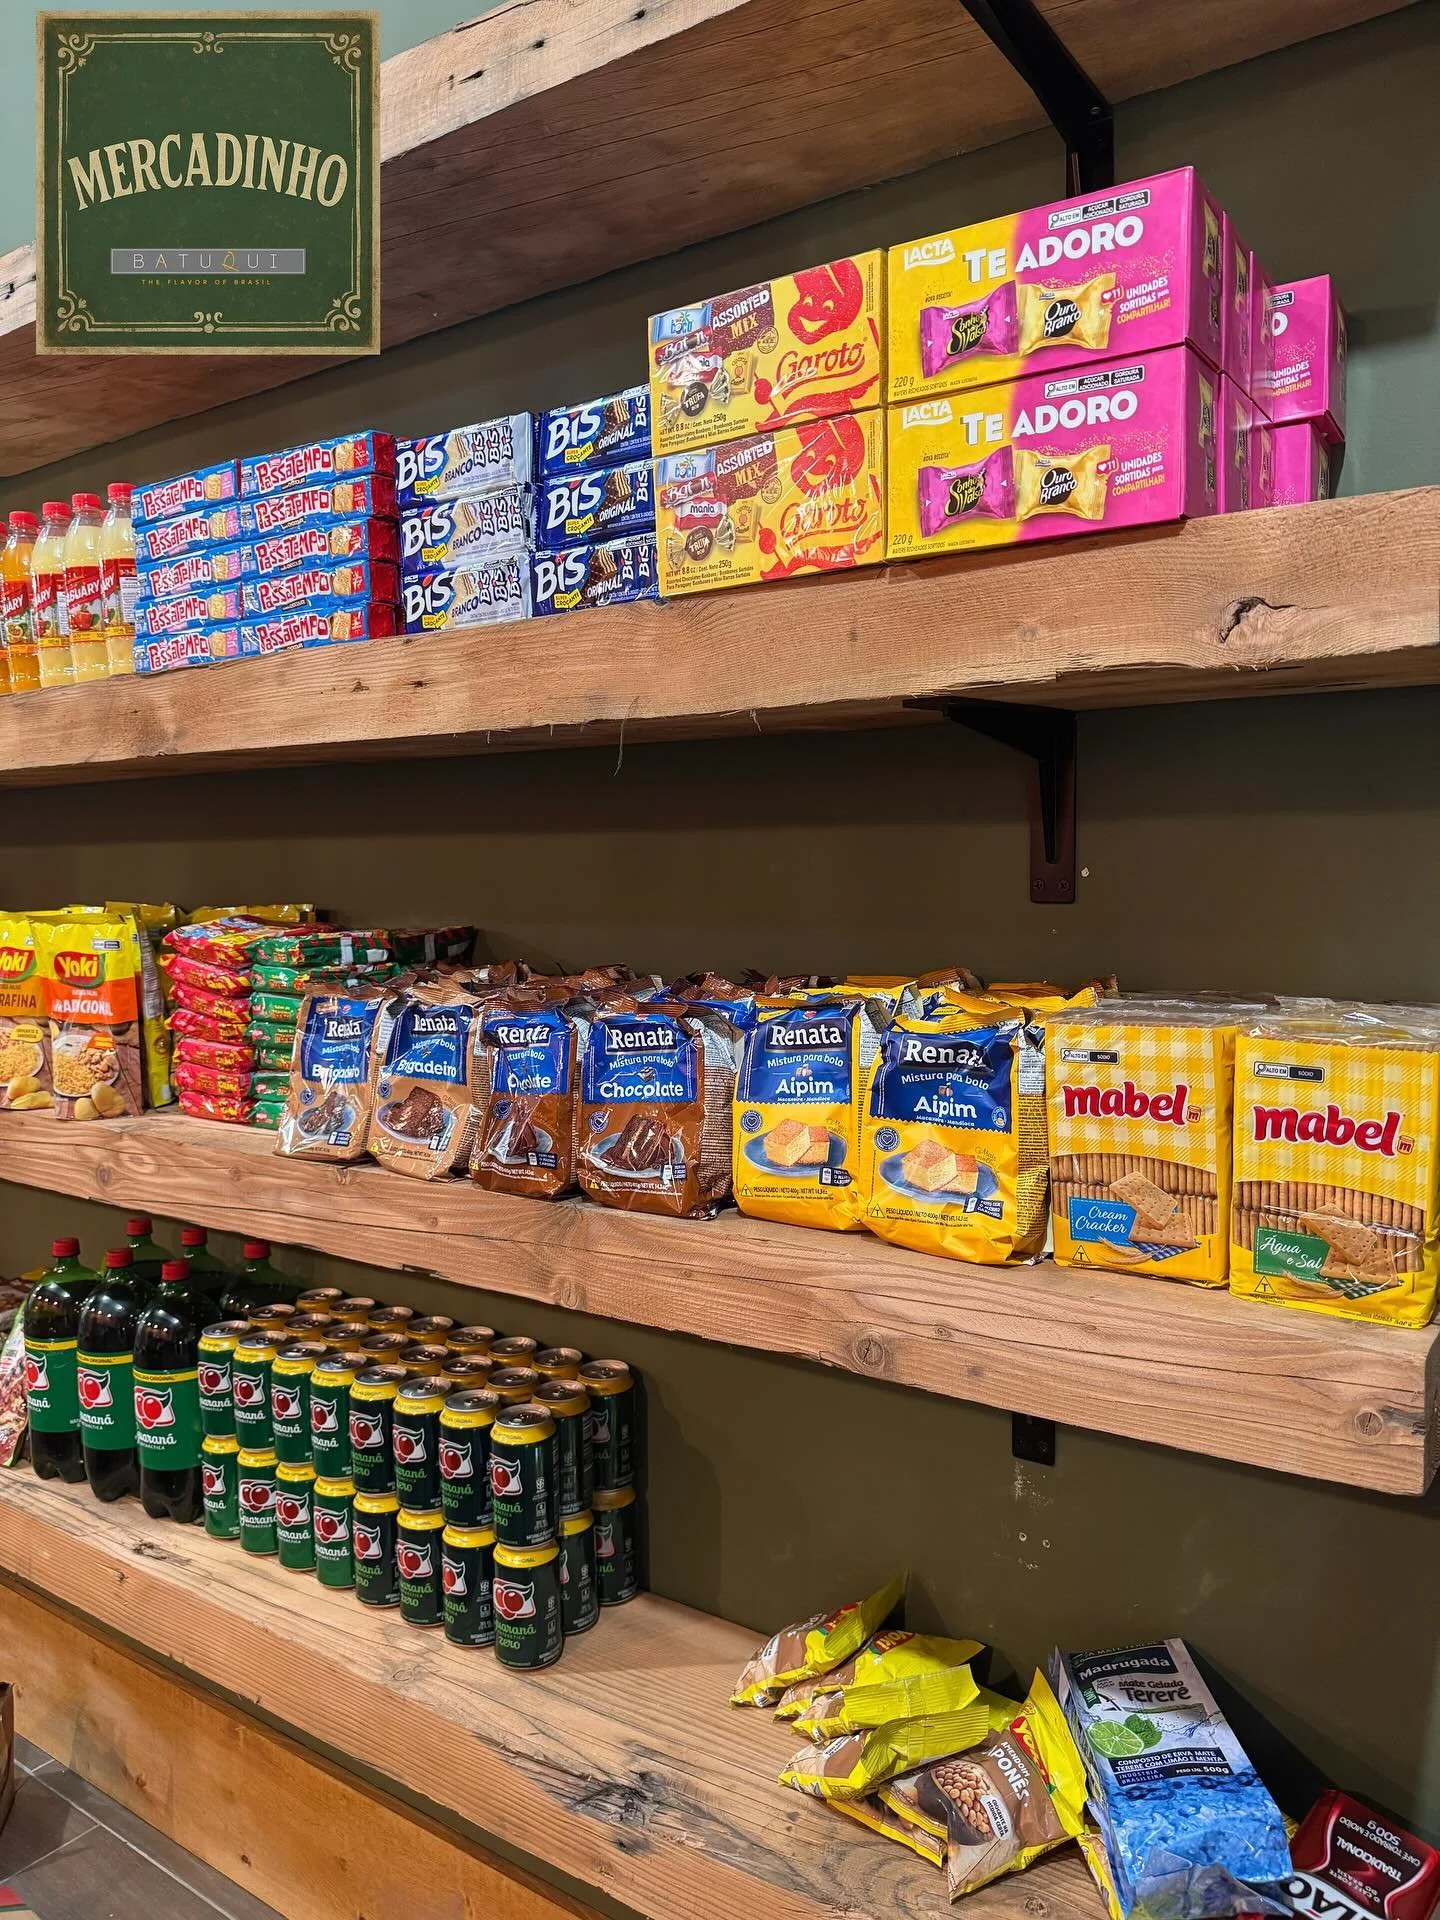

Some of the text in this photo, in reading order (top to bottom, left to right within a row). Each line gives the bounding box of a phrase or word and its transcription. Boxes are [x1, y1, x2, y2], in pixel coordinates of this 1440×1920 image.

[904, 238, 955, 268] LACTA
[964, 216, 1144, 282] TE ADORO
[1126, 276, 1168, 300] UNIDADES
[712, 290, 770, 331] ASSORTED
[1119, 292, 1156, 313] SORTIDAS
[730, 312, 759, 340] MIX
[1043, 309, 1082, 338] Branco
[776, 343, 865, 383] Garoto
[894, 376, 908, 388] 220
[713, 413, 727, 423] 250g
[902, 400, 952, 426] LACTA
[961, 390, 1138, 445] TE ADORO
[598, 422, 635, 450] ORIGINAL
[717, 440, 774, 477] ASSORTED
[1121, 452, 1163, 472] UNIDADES
[444, 458, 473, 483] BRANCO
[735, 464, 764, 488] MIX
[1114, 468, 1151, 486] SORTIDAS
[1040, 479, 1078, 505] Branco
[1112, 475, 1166, 497] COMPARTILHAR!
[599, 496, 636, 522] ORIGINAL
[690, 503, 715, 513] mania
[453, 529, 482, 550] BRANCO
[893, 534, 907, 545] 220
[719, 560, 732, 568] 250g
[68, 580, 99, 601] GUARY
[587, 576, 622, 597] ORIGINAL
[452, 595, 477, 618] BRANCO
[57, 956, 98, 977] Yoki
[0, 994, 37, 1008] RAFINA
[611, 1028, 674, 1049] Renata
[770, 1024, 843, 1047] Renata
[609, 1057, 642, 1071] Mistura
[643, 1055, 660, 1066] para
[767, 1053, 844, 1069] Mistura para bolo
[600, 1082, 684, 1098] Chocolate
[776, 1077, 834, 1097] Aipim
[901, 1072, 944, 1085] Mistura
[965, 1075, 989, 1091] bolo
[914, 1096, 977, 1119] Aipim
[1063, 1082, 1187, 1125] mabel
[1254, 1105, 1400, 1156] mabel
[1088, 1206, 1128, 1222] Cream
[1075, 1216, 1127, 1234] Cracker
[1260, 1233, 1301, 1256] Água
[1286, 1254, 1323, 1269] e Sal
[499, 1636, 520, 1649] zero
[1079, 1658, 1170, 1680] Madrugada
[1119, 1680, 1146, 1688] Mate
[1147, 1680, 1184, 1689] Gelado
[1120, 1686, 1192, 1703] Tererê
[1001, 1741, 1030, 1777] AMENDOIM
[1116, 1763, 1144, 1772] TERERÊ
[1145, 1760, 1163, 1768] COM
[1164, 1756, 1189, 1766] LIMÃO
[1118, 1755, 1160, 1766] COMPOSTO
[988, 1745, 1031, 1801] PONÊS
[1122, 1774, 1164, 1785] BRASILEIRA
[1203, 1766, 1229, 1774] 500g
[1339, 1816, 1364, 1833] MOÍDO
[1366, 1820, 1401, 1846] 500 g
[1369, 1833, 1402, 1856] TORRADO
[1336, 1836, 1402, 1881] TRADICIONAL
[1402, 1853, 1421, 1867] CAFÉ
